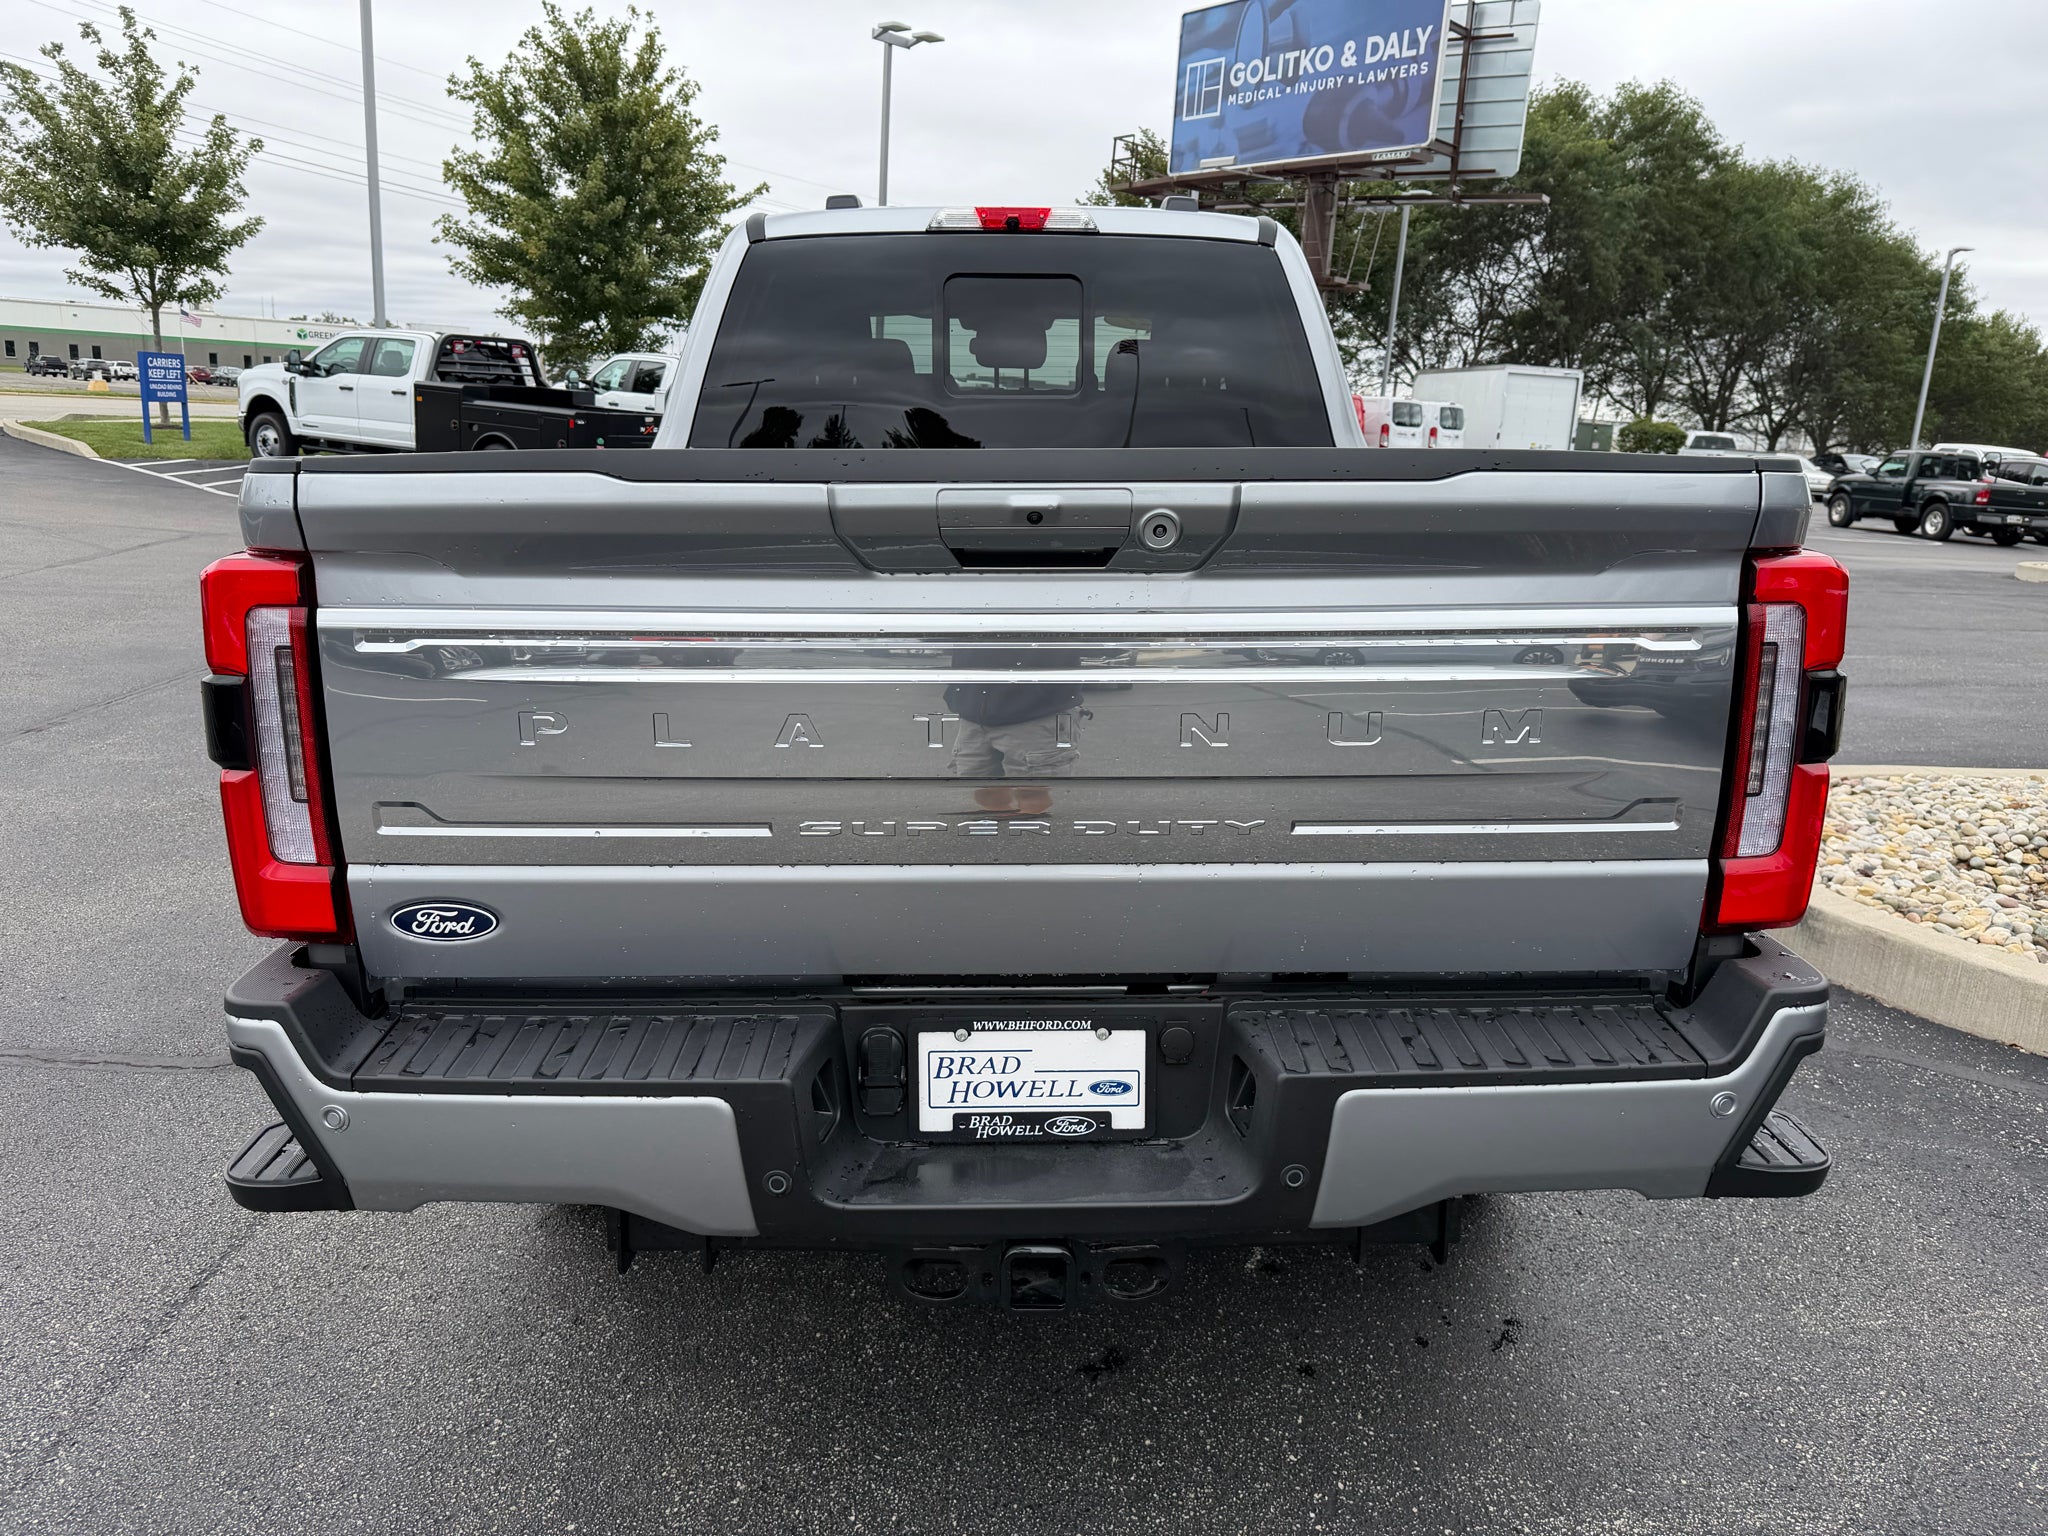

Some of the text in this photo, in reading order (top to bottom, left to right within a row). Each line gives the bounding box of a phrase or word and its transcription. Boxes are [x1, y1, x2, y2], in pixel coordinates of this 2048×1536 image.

[1229, 25, 1434, 87] GOLITKO & DALY
[1227, 61, 1430, 107] MEDICAL INJURY LAWYERS
[308, 330, 340, 339] GREEN
[147, 357, 181, 368] CARRIERS
[148, 369, 181, 379] KEEP LEFT
[517, 708, 1544, 749] PLATINUM
[799, 819, 1265, 837] SUPER DUTY
[411, 909, 476, 934] Ford
[973, 1020, 1092, 1031] WWW.BHIFORD.COM
[933, 1055, 1022, 1080] BRAD
[947, 1079, 1083, 1104] HOWELL
[969, 1115, 1012, 1128] BRAD
[1052, 1118, 1089, 1134] Ford
[976, 1125, 1043, 1138] HOWELL
